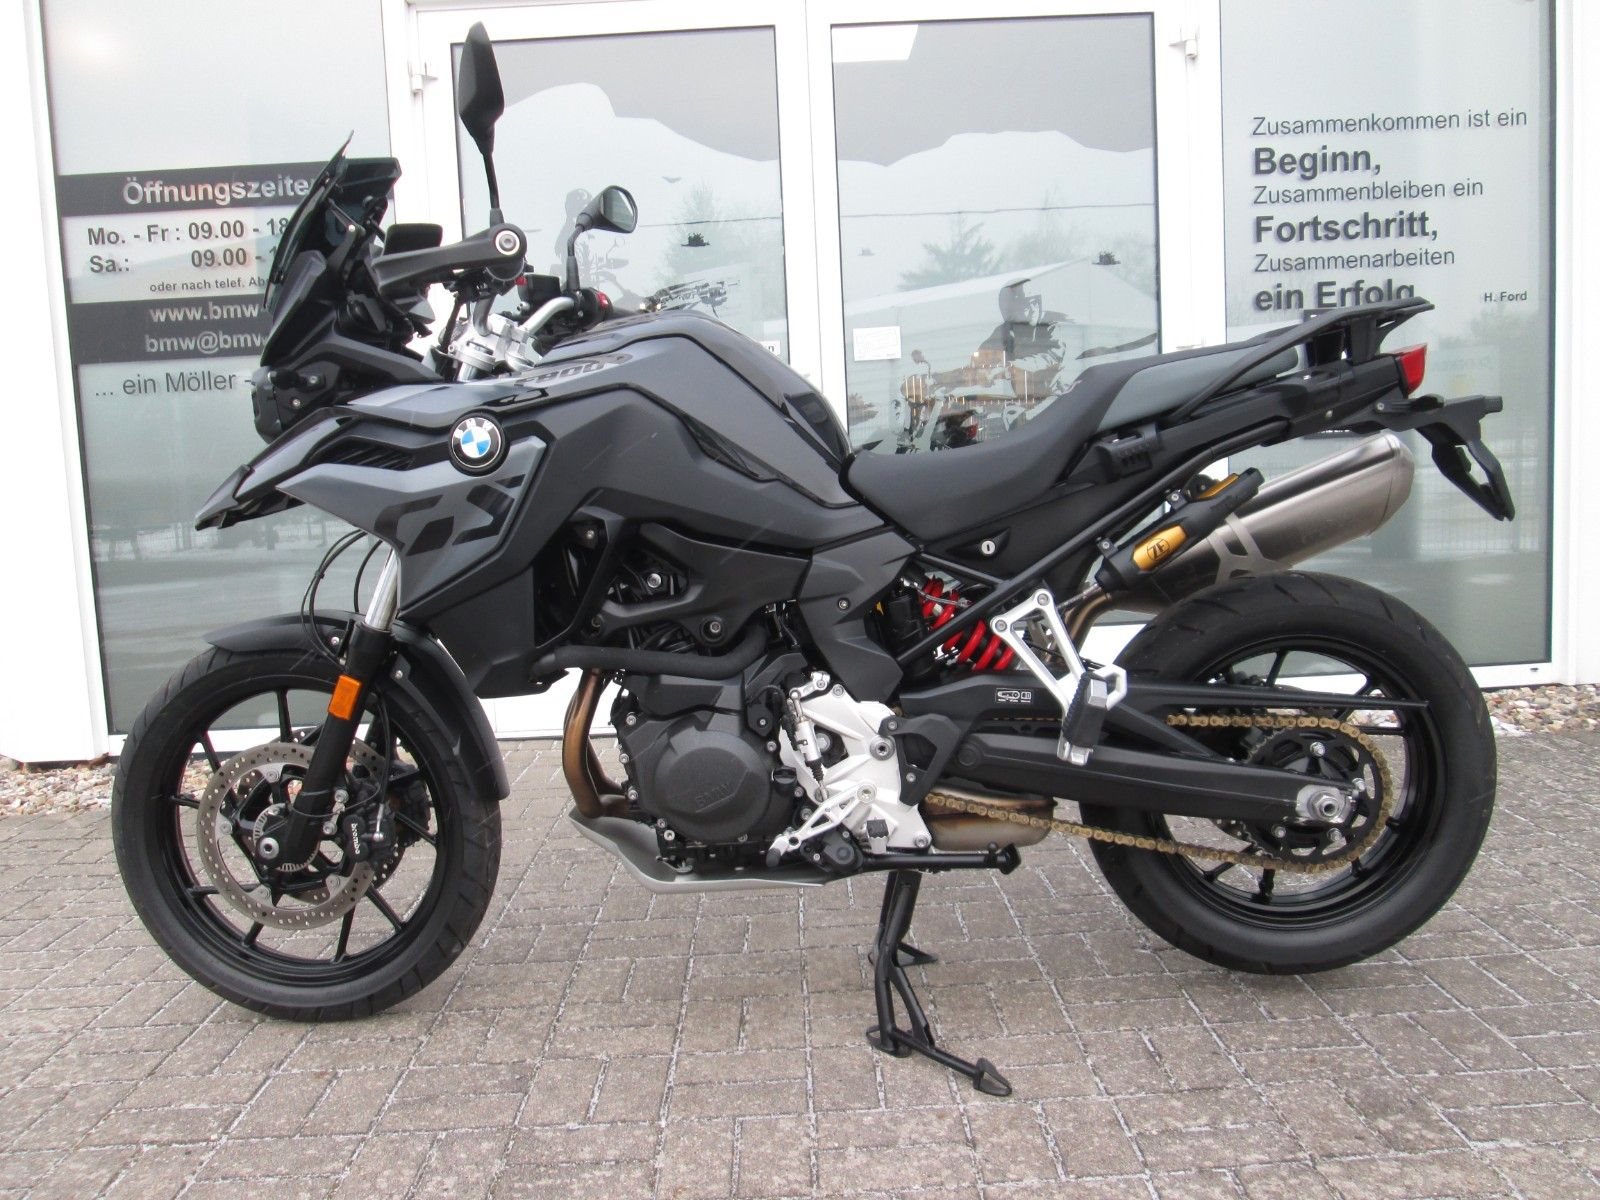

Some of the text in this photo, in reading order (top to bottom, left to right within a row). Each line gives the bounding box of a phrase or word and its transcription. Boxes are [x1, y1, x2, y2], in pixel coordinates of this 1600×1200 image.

[1252, 108, 1527, 136] Zusammenkommen ist ein
[1254, 145, 1381, 181] Beginn,
[1253, 178, 1483, 204] Zusammenbleiben ein
[88, 227, 126, 246] Mo.
[147, 225, 169, 242] Fr
[188, 220, 245, 240] 09.00
[1255, 210, 1438, 243] Fortschritt,
[90, 256, 130, 274] Sa.:
[191, 247, 247, 268] 09.00
[1254, 249, 1455, 272] Zusammenarbeiten
[150, 281, 177, 293] oder
[181, 279, 211, 291] nach
[215, 277, 245, 290] telef.
[1255, 284, 1304, 311] ein
[1484, 291, 1528, 303] H. Ford
[123, 375, 156, 395] ein
[166, 370, 236, 393] Möller
